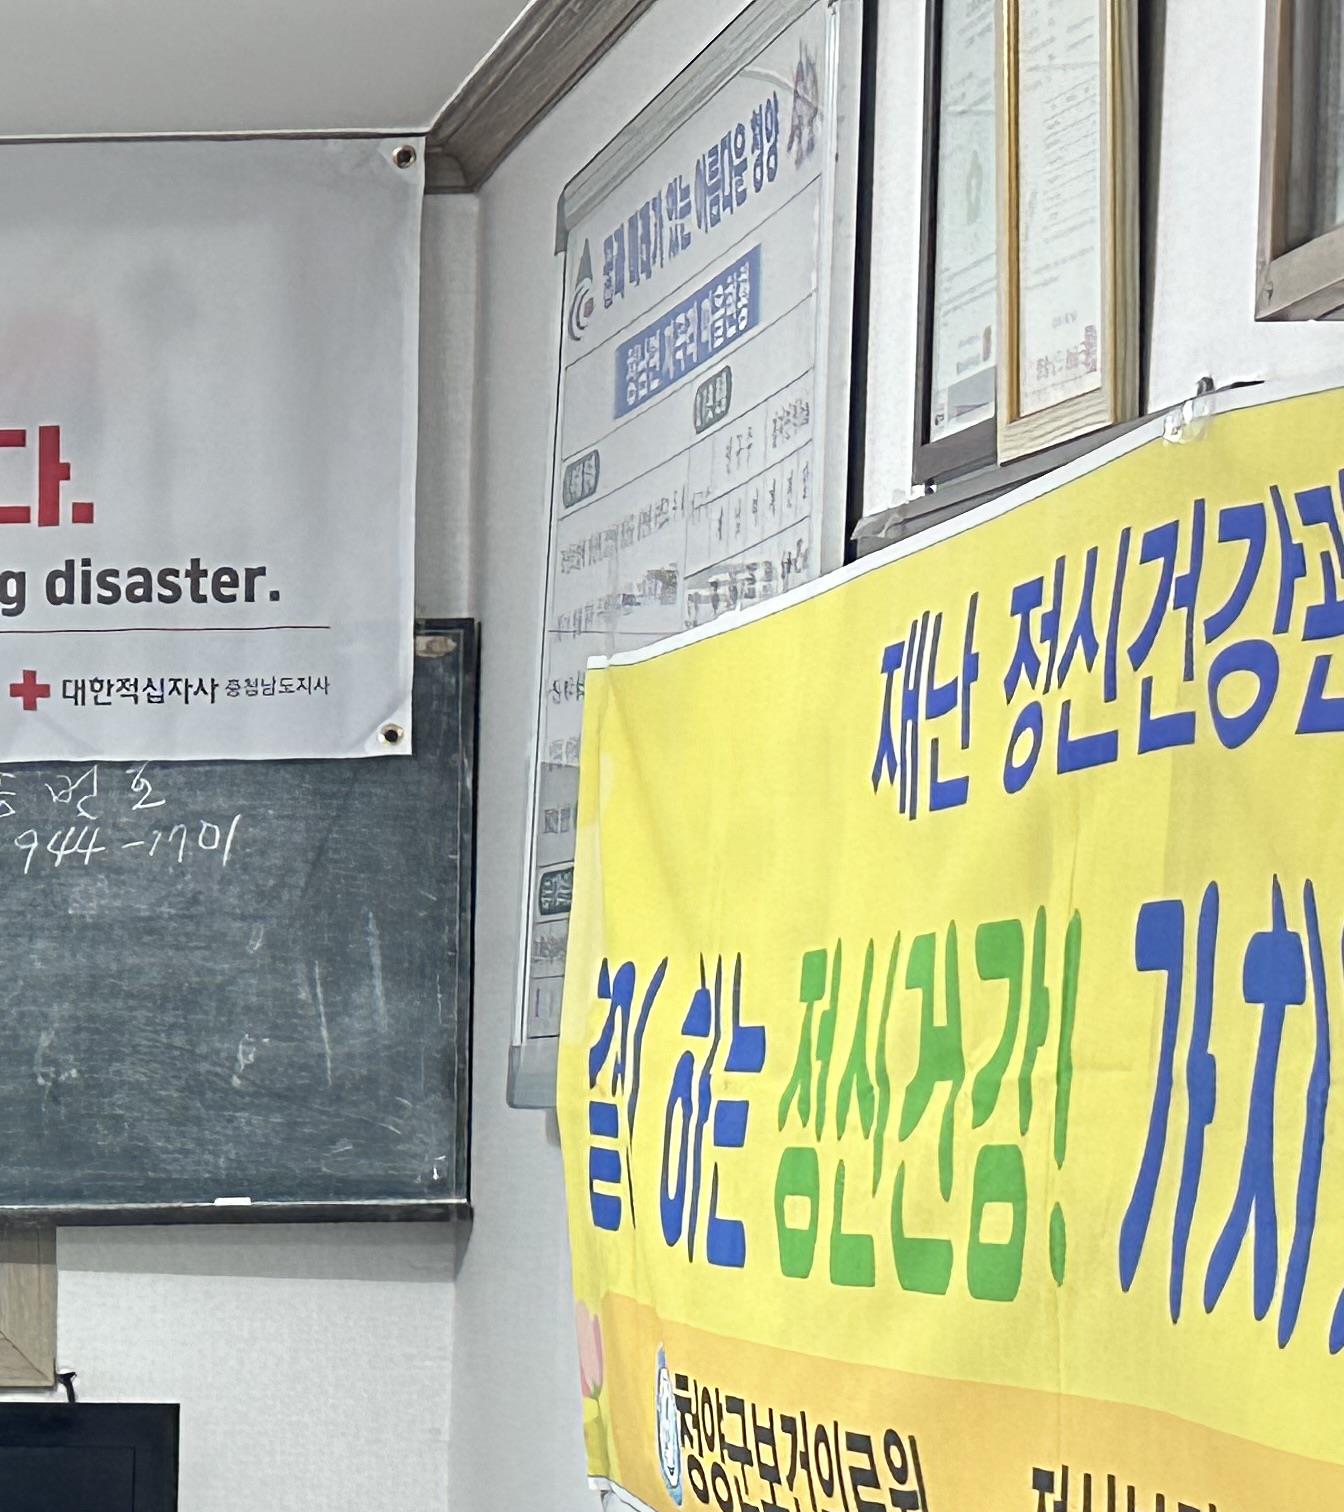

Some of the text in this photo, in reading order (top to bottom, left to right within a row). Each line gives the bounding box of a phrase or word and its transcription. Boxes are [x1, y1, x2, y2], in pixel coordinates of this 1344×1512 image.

[45, 557, 281, 606] disaster.
[60, 676, 330, 706] 대한적십자사 충청남도지사
[872, 592, 979, 821] 재난
[660, 952, 766, 1268] 하는
[775, 905, 1082, 1302] 정신건강!
[1118, 873, 1344, 1354] 가치
